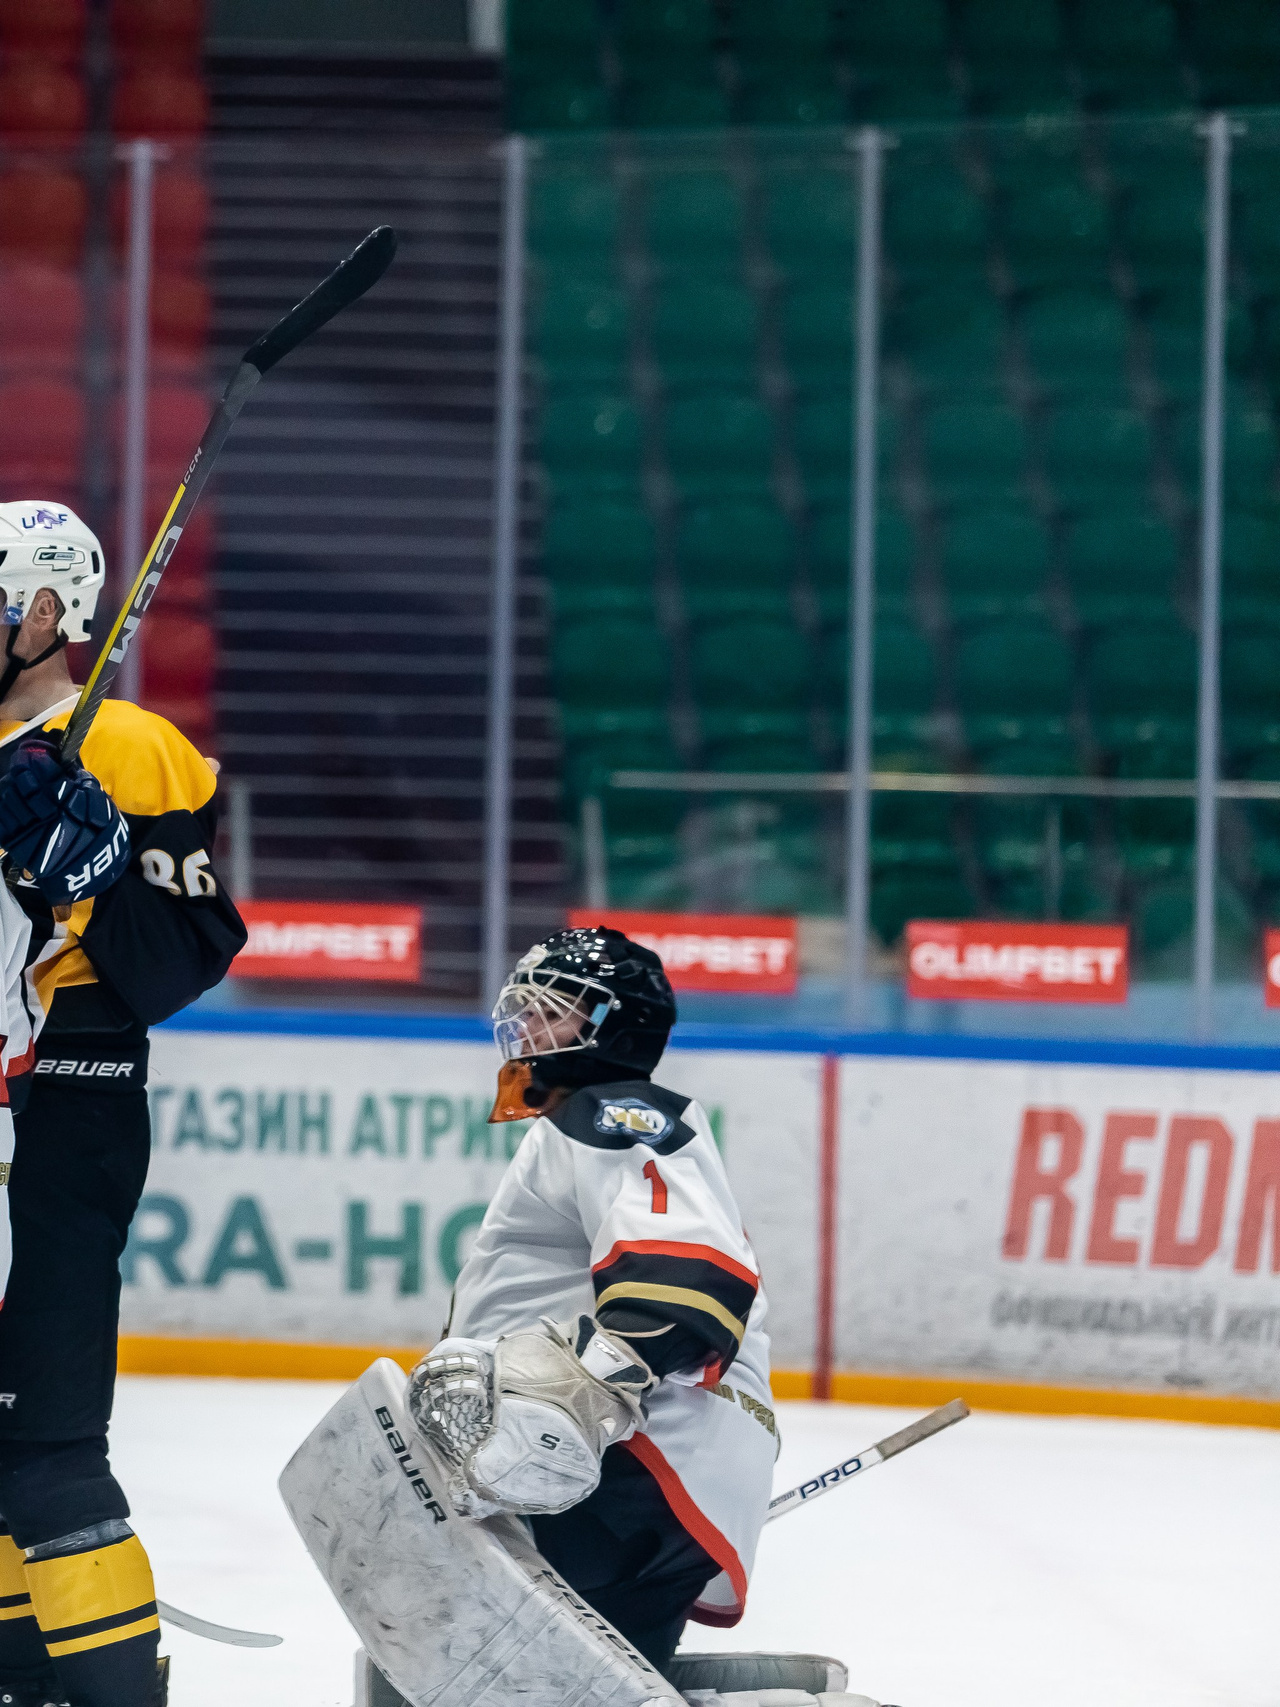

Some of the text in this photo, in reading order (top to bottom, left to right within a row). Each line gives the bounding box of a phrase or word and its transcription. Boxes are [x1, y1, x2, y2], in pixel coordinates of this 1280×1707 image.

[183, 446, 202, 484] CCM
[108, 525, 183, 663] CCM
[910, 941, 1122, 985] OLIMPBET
[642, 1159, 668, 1214] 1
[799, 1457, 862, 1499] PRO
